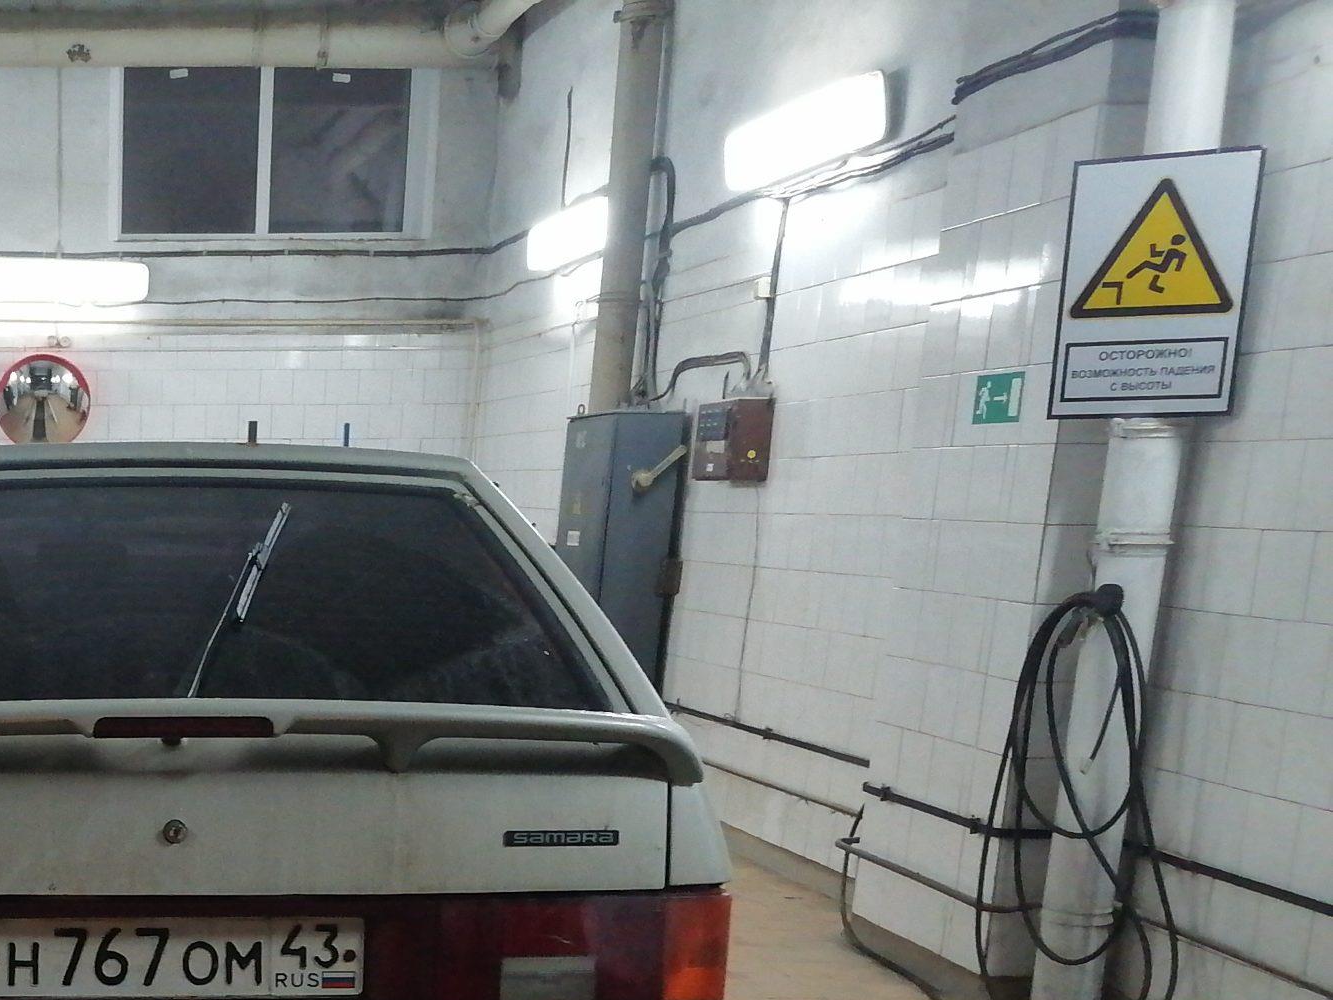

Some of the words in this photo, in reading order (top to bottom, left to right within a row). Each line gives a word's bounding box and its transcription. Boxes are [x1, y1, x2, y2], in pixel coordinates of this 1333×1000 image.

[1071, 367, 1157, 379] ВОЗМОЖНОСТЬ
[1160, 365, 1216, 376] ПАДЕНИЯ
[1110, 382, 1118, 391] С
[1121, 381, 1172, 391] ВЫСОТЫ
[281, 923, 339, 969] 43
[275, 972, 320, 988] RUS
